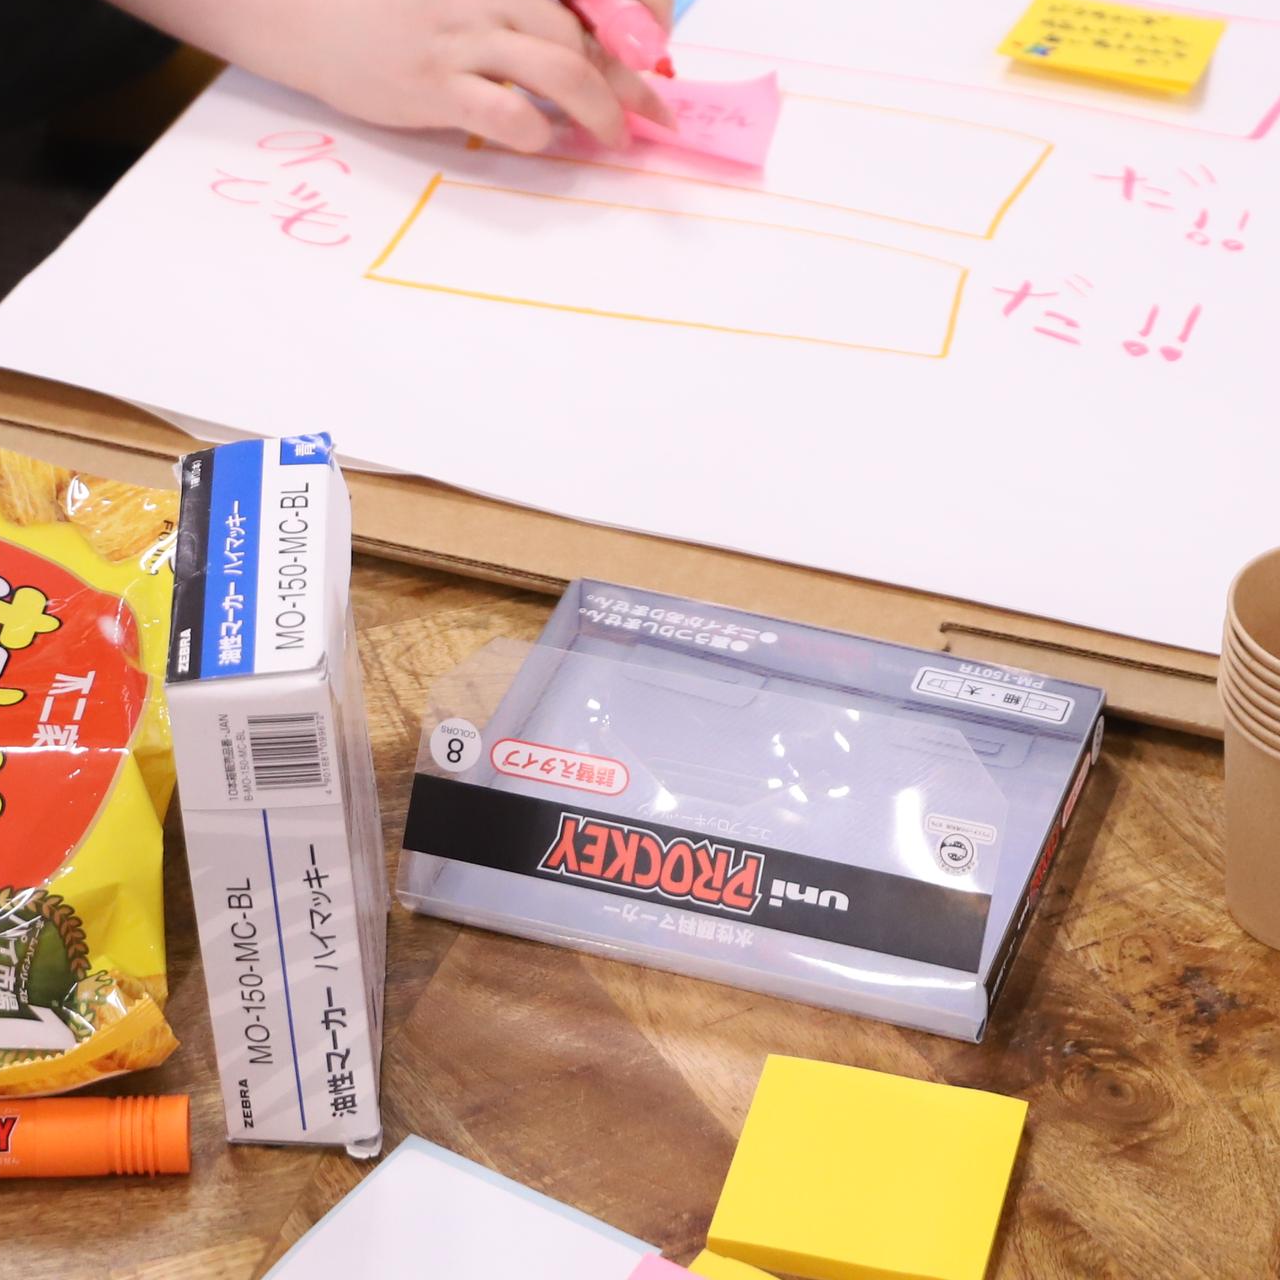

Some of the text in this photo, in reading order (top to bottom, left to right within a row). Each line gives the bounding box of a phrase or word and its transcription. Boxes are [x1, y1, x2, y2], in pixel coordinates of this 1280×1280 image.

[218, 500, 247, 665] 油性マーカー ハイマッキー
[275, 482, 309, 650] MO-150-MC-BL
[178, 628, 192, 673] ZEBRA
[440, 724, 477, 740] COLORS
[446, 738, 465, 763] 8
[502, 750, 617, 788] 詰替えタイプ
[537, 811, 766, 916] PROCKEY
[768, 879, 850, 912] uni
[226, 878, 273, 1064] MO-150-MC-BL
[303, 844, 359, 1118] 油性マーカー ハイマッキー
[238, 1078, 255, 1129] ZEBRA
